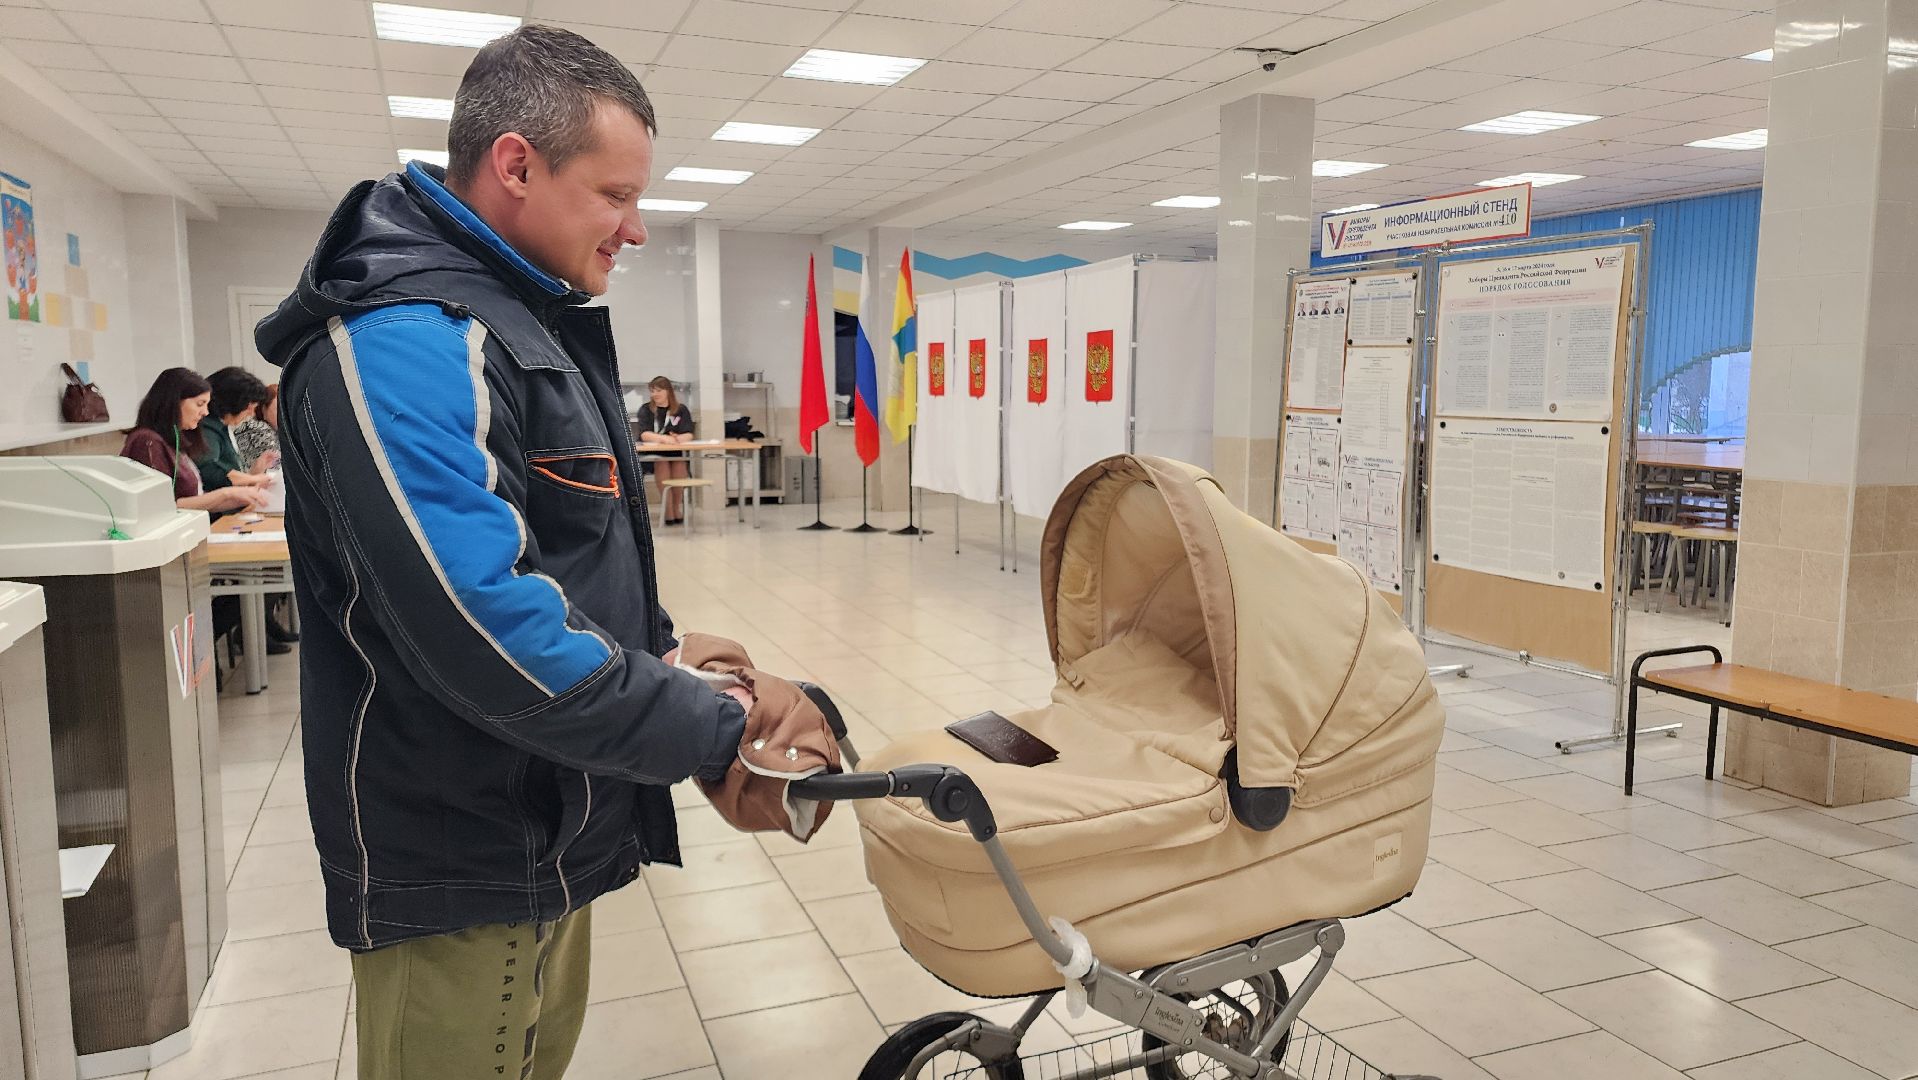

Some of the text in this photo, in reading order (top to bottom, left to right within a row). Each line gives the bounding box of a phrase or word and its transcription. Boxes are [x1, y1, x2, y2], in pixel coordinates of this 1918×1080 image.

[1384, 198, 1518, 228] ИНФОРМАЦИОННЫЙ СТЕНД
[1479, 279, 1571, 292] ПОРЯДОК ГОЛОСОВАНИЯ
